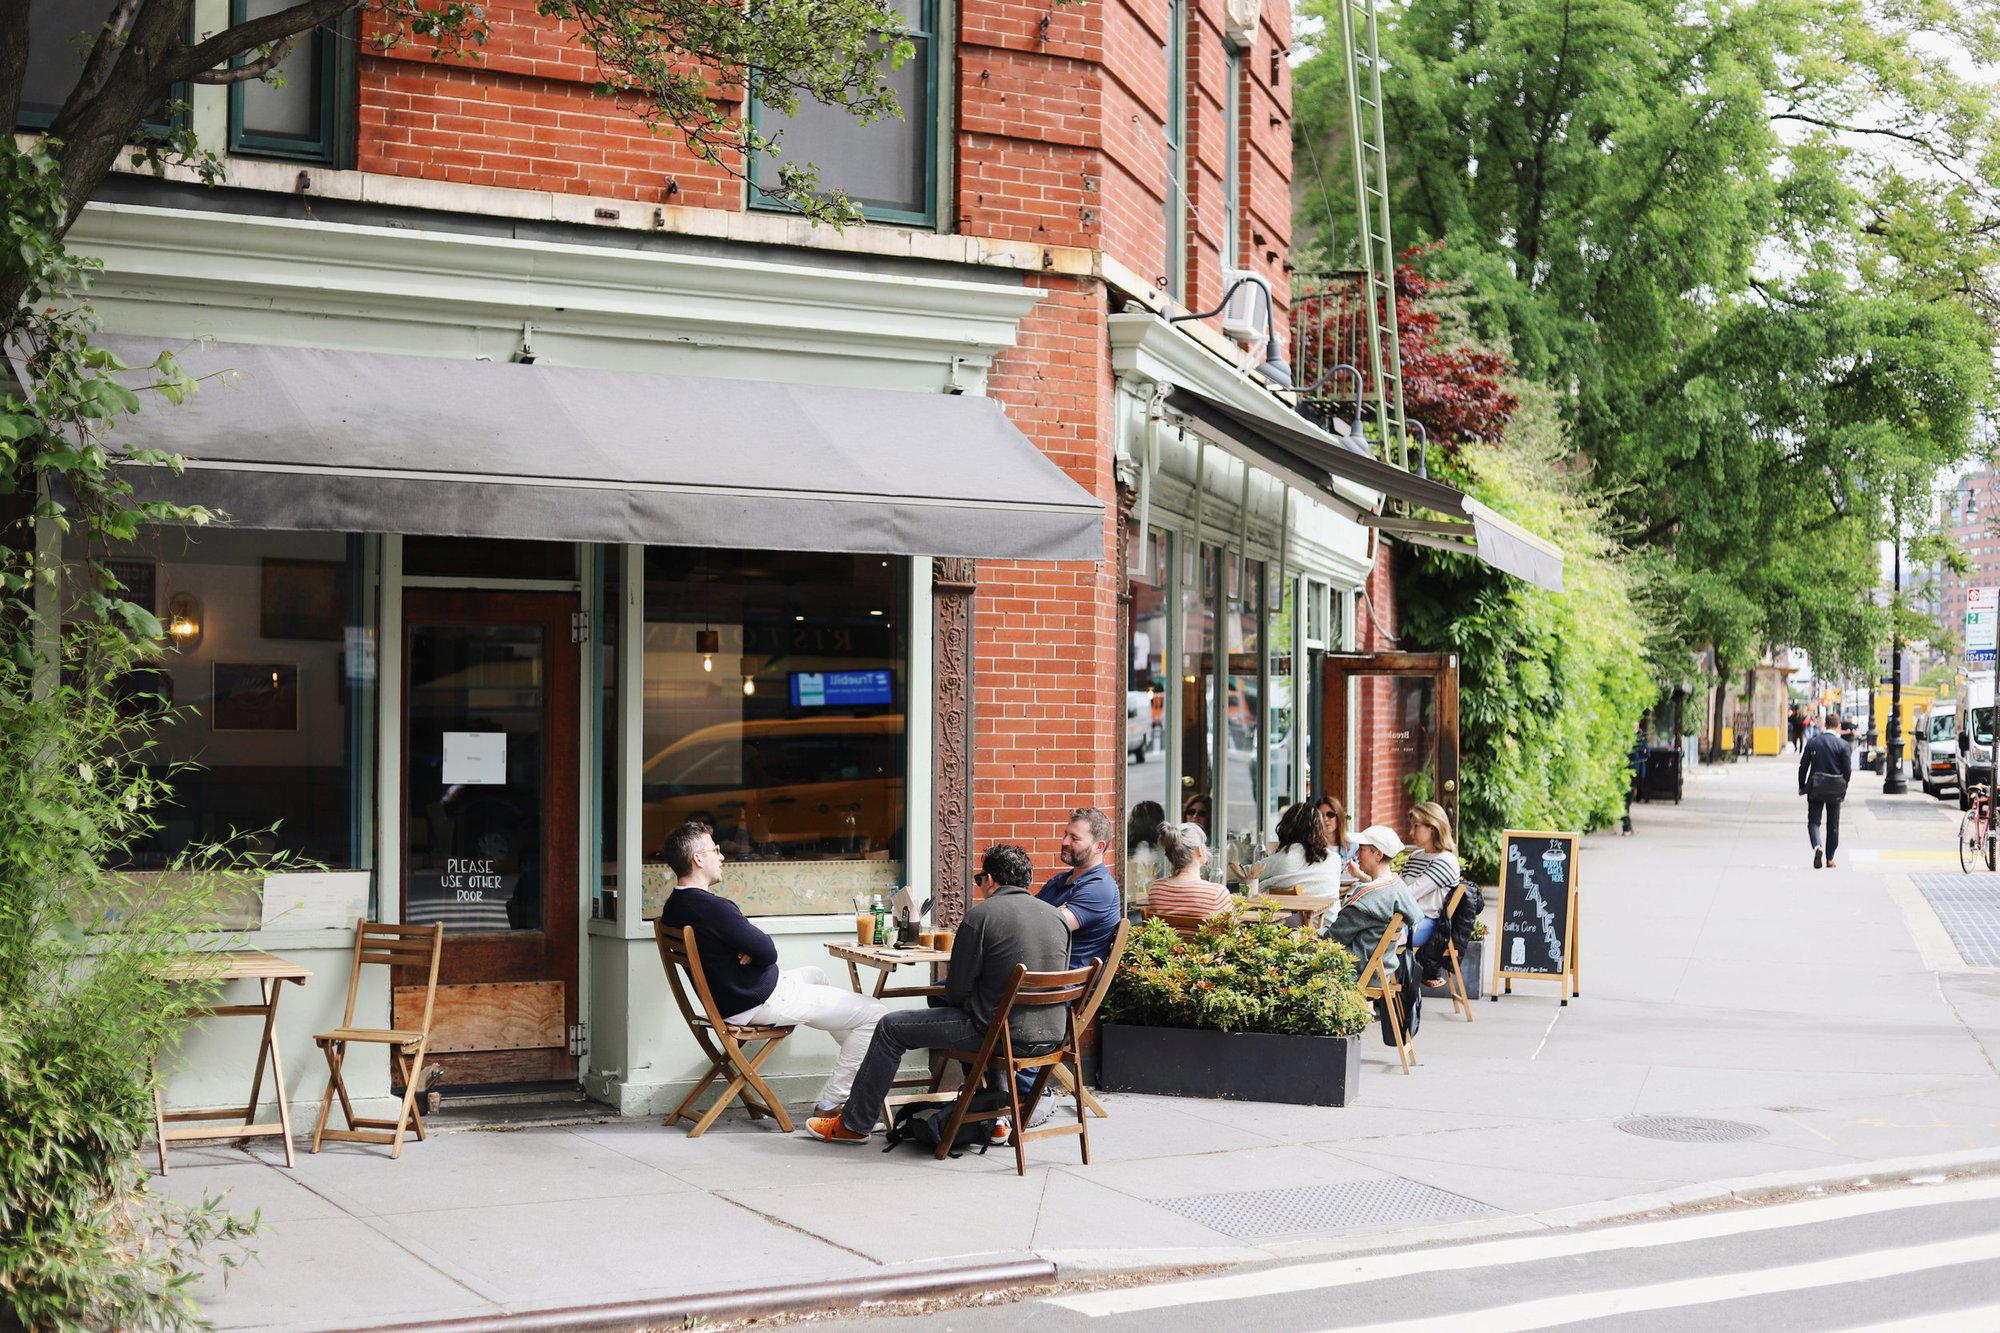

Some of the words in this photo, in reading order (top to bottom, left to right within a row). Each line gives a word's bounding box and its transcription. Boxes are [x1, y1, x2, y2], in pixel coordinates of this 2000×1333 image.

[447, 858, 494, 874] PLEASE
[441, 875, 463, 888] USE
[469, 875, 502, 889] OTHER
[456, 890, 483, 902] DOOR
[1509, 844, 1564, 972] BREAKFAST
